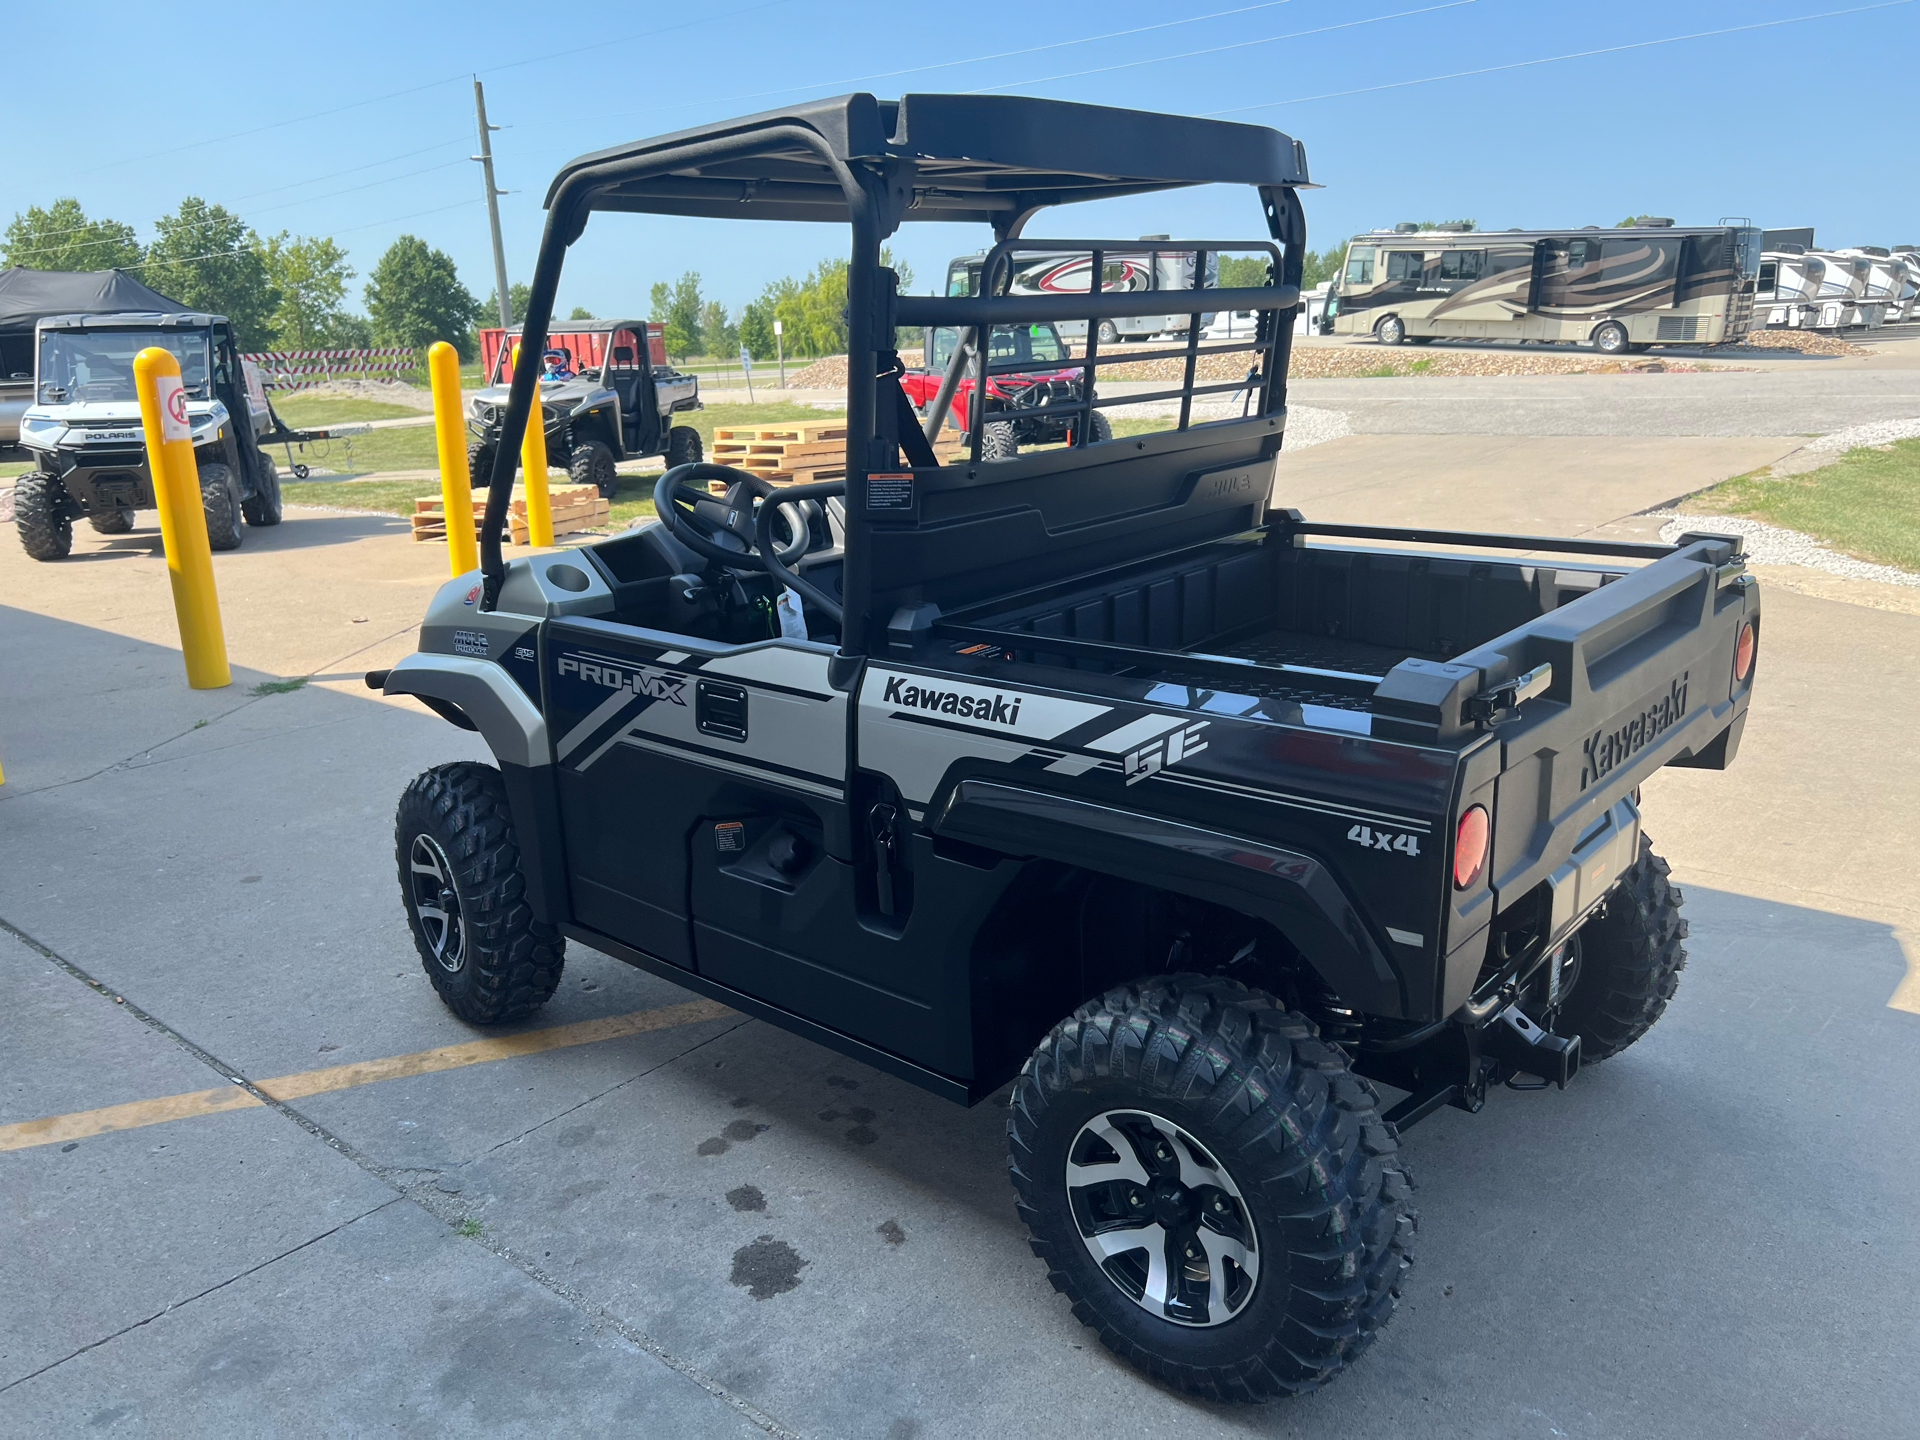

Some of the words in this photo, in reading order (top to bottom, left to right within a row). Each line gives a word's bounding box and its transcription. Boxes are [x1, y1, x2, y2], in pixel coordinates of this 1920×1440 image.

[85, 432, 136, 440] POLARIS
[453, 630, 489, 648] MULE
[558, 657, 688, 707] PRO-MX
[883, 676, 1022, 726] Kawasaki
[1580, 670, 1689, 792] Kawasaki
[1347, 824, 1421, 857] 4x4
